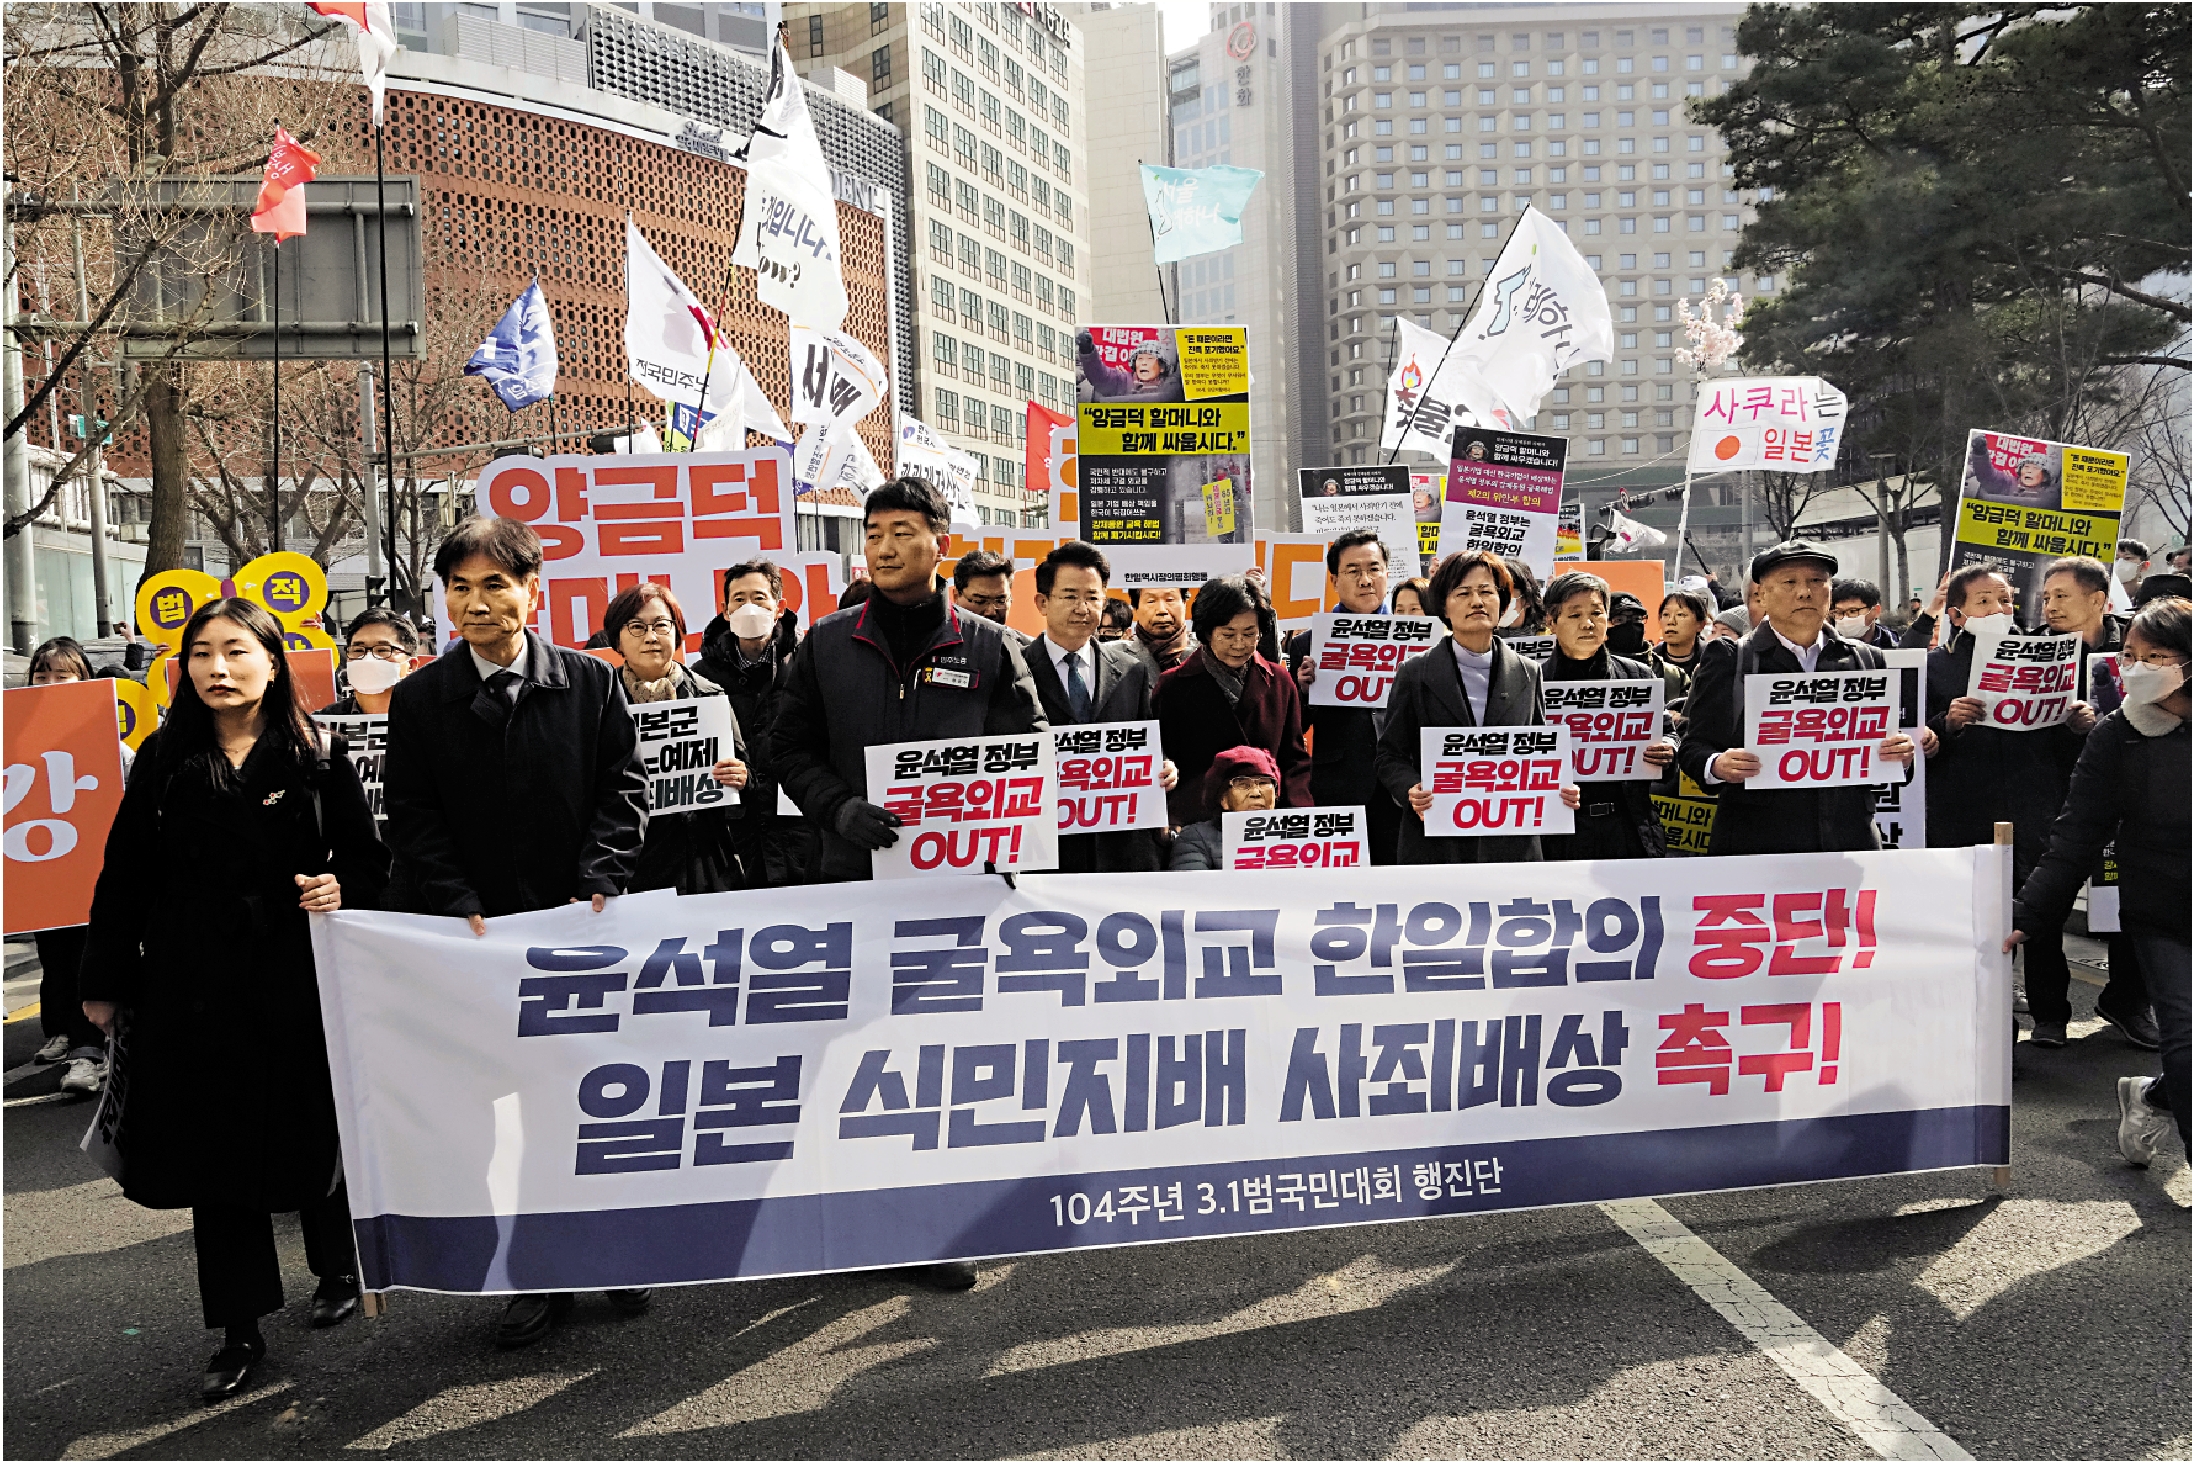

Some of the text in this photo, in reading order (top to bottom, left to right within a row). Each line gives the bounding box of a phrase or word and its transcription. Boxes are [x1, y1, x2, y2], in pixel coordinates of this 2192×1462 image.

[1102, 327, 1144, 345] 대법원
[1084, 408, 1221, 428] “양금덕 할머니와
[1704, 387, 1843, 424] 사쿠라는
[1122, 432, 1157, 452] 함께
[1996, 434, 2034, 455] 대법원
[489, 459, 783, 561] 양금덕
[1966, 502, 2092, 536] “양금덕 할머니와
[1468, 523, 1526, 541] 굴욕외교
[1996, 528, 2030, 548] 함께
[271, 577, 302, 607] 적
[1331, 619, 1432, 642] 윤석열 정부
[1319, 642, 1432, 672] 굴욕외
[1994, 638, 2077, 662] 윤석열 정부
[1770, 677, 1887, 705] 윤석열 정부
[1978, 662, 2076, 694] 굴욕외교
[1544, 686, 1652, 710] 윤석열 정부
[1993, 696, 2067, 726] OUT!
[632, 705, 698, 742] 본군
[1757, 706, 1890, 745] 굴욕외교
[1106, 727, 1147, 753] 정부
[1442, 731, 1557, 757] 윤석열 정부
[894, 741, 1039, 780] 윤석열 정부
[1056, 755, 1153, 791] 욕외교
[1572, 746, 1636, 775] UT!
[1778, 746, 1871, 782] OUT!
[1432, 758, 1562, 794] 굴욕외교
[884, 777, 1044, 827] 굴욕외교
[1057, 793, 1138, 828] OUT!
[1452, 796, 1545, 829] OUT!
[1655, 799, 1712, 828] 머니와
[1244, 813, 1355, 841] 윤석열 정부
[910, 825, 1023, 870] OUT!
[518, 888, 1877, 1037] 윤석열 굴욕외교 한일합의 중단!
[574, 1001, 1842, 1176] 일본 식민지배 사죄배상 촉구!
[1049, 1157, 1504, 1227] 104주년 3.1범국민대회 행진단
